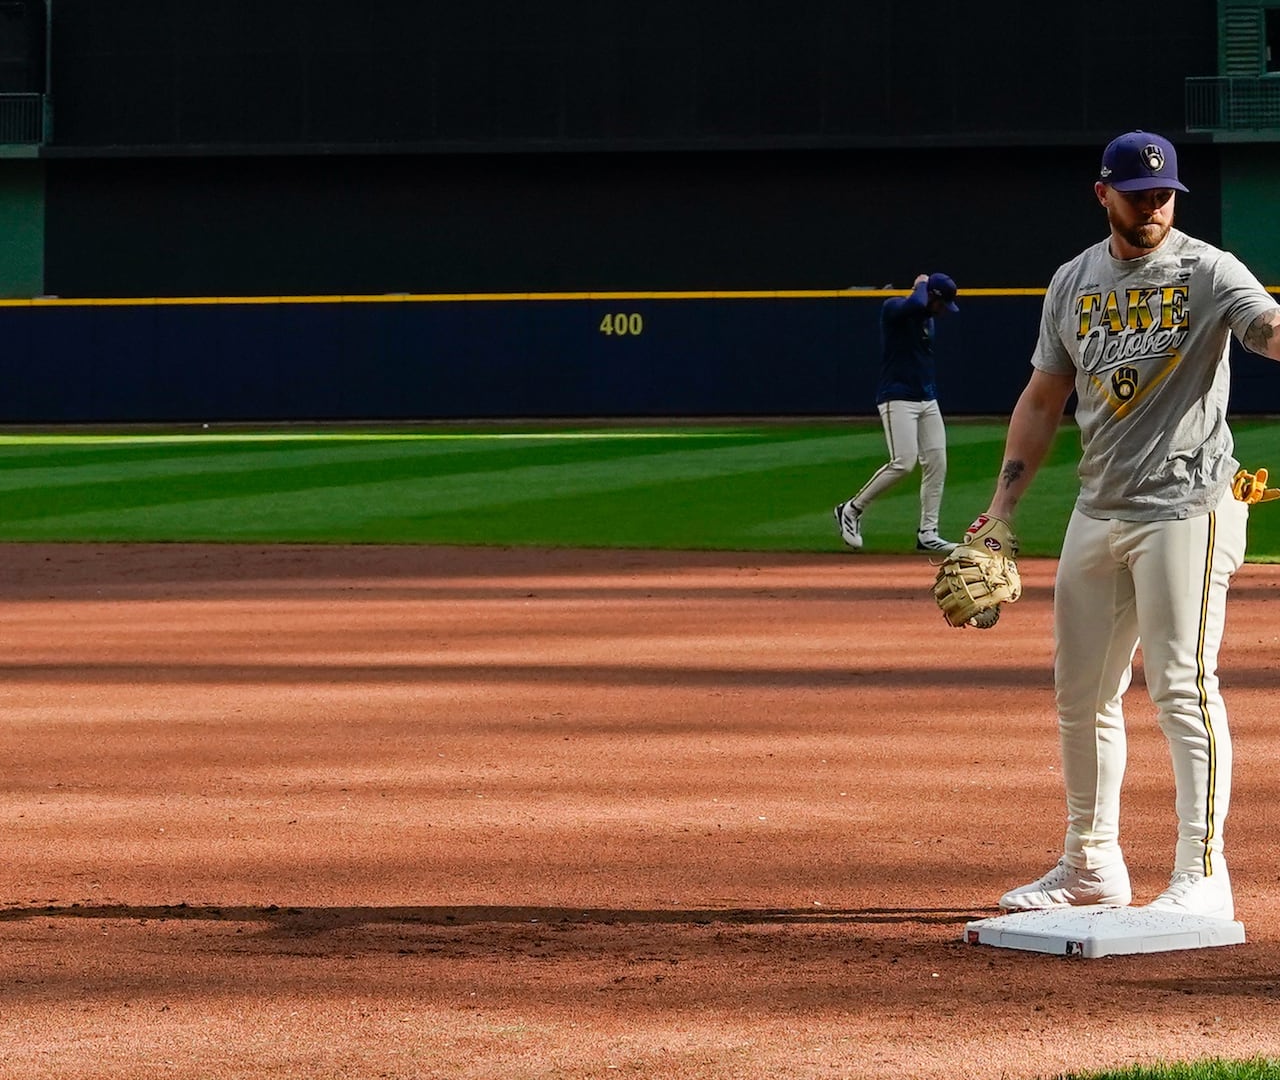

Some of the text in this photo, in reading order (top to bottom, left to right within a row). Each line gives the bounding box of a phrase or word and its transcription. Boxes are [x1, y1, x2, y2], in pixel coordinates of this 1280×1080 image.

[600, 313, 643, 335] 400
[1075, 286, 1190, 340] TAKE
[1078, 319, 1188, 372] October
